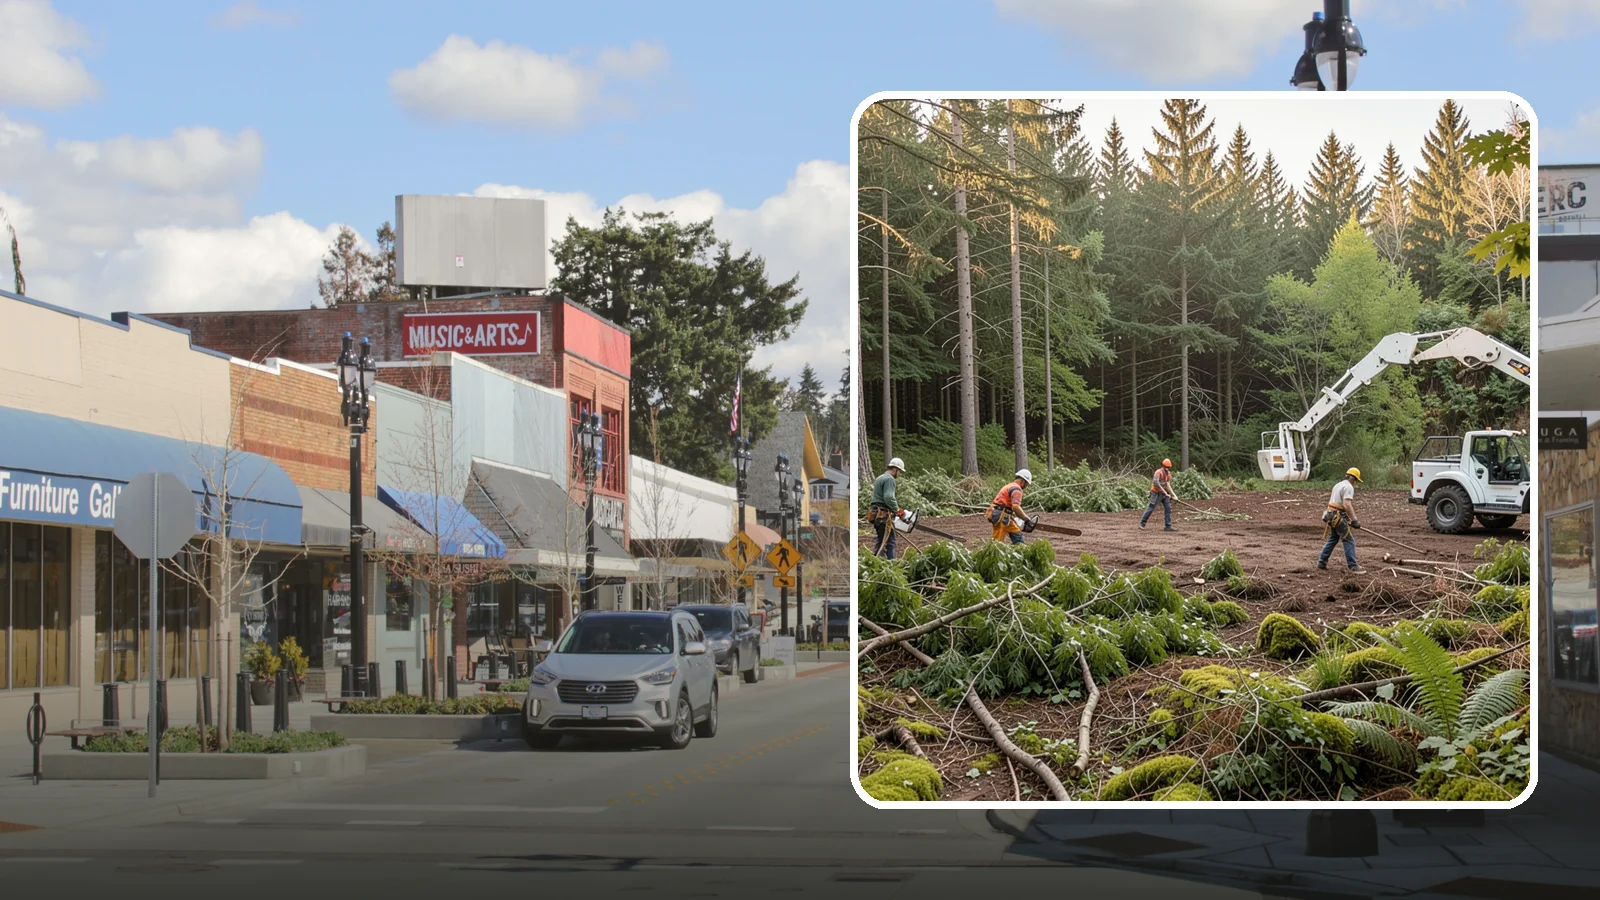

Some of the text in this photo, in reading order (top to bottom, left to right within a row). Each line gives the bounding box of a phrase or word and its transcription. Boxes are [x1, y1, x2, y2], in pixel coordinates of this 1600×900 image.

[1540, 427, 1577, 437] UGA
[0, 471, 79, 515] Furniture
[454, 563, 479, 574] SUSHI
